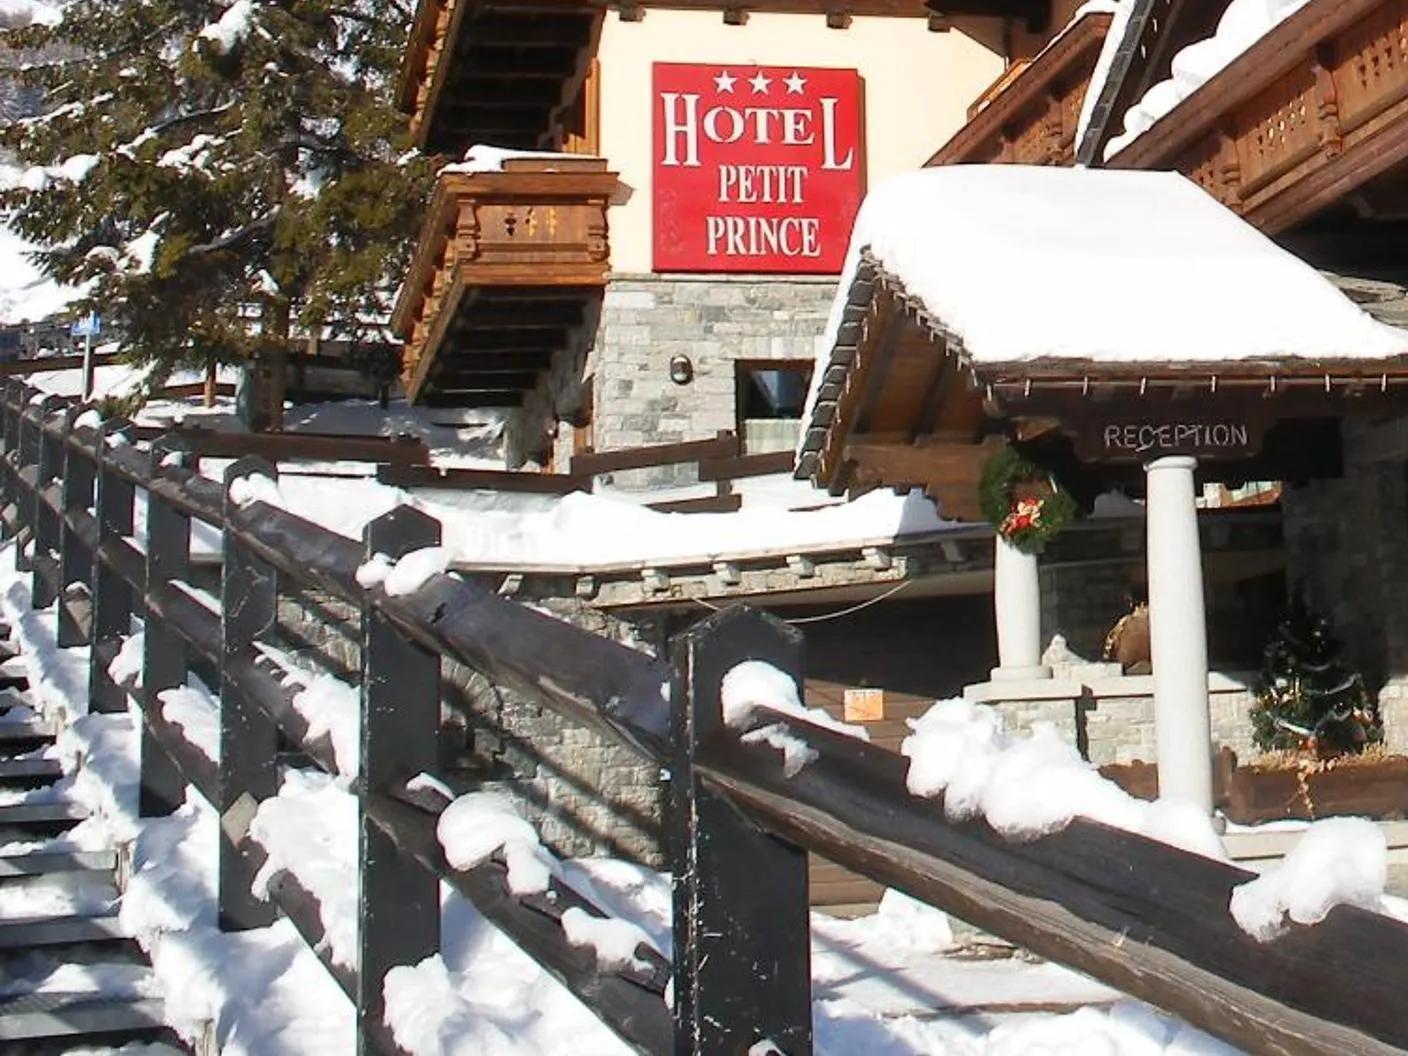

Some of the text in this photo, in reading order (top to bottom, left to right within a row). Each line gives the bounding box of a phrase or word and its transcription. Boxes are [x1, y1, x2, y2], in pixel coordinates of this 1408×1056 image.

[660, 92, 853, 170] HOTEL
[718, 164, 808, 203] PETIT
[706, 216, 821, 257] PRINCE
[1104, 424, 1248, 450] RECEPTION
